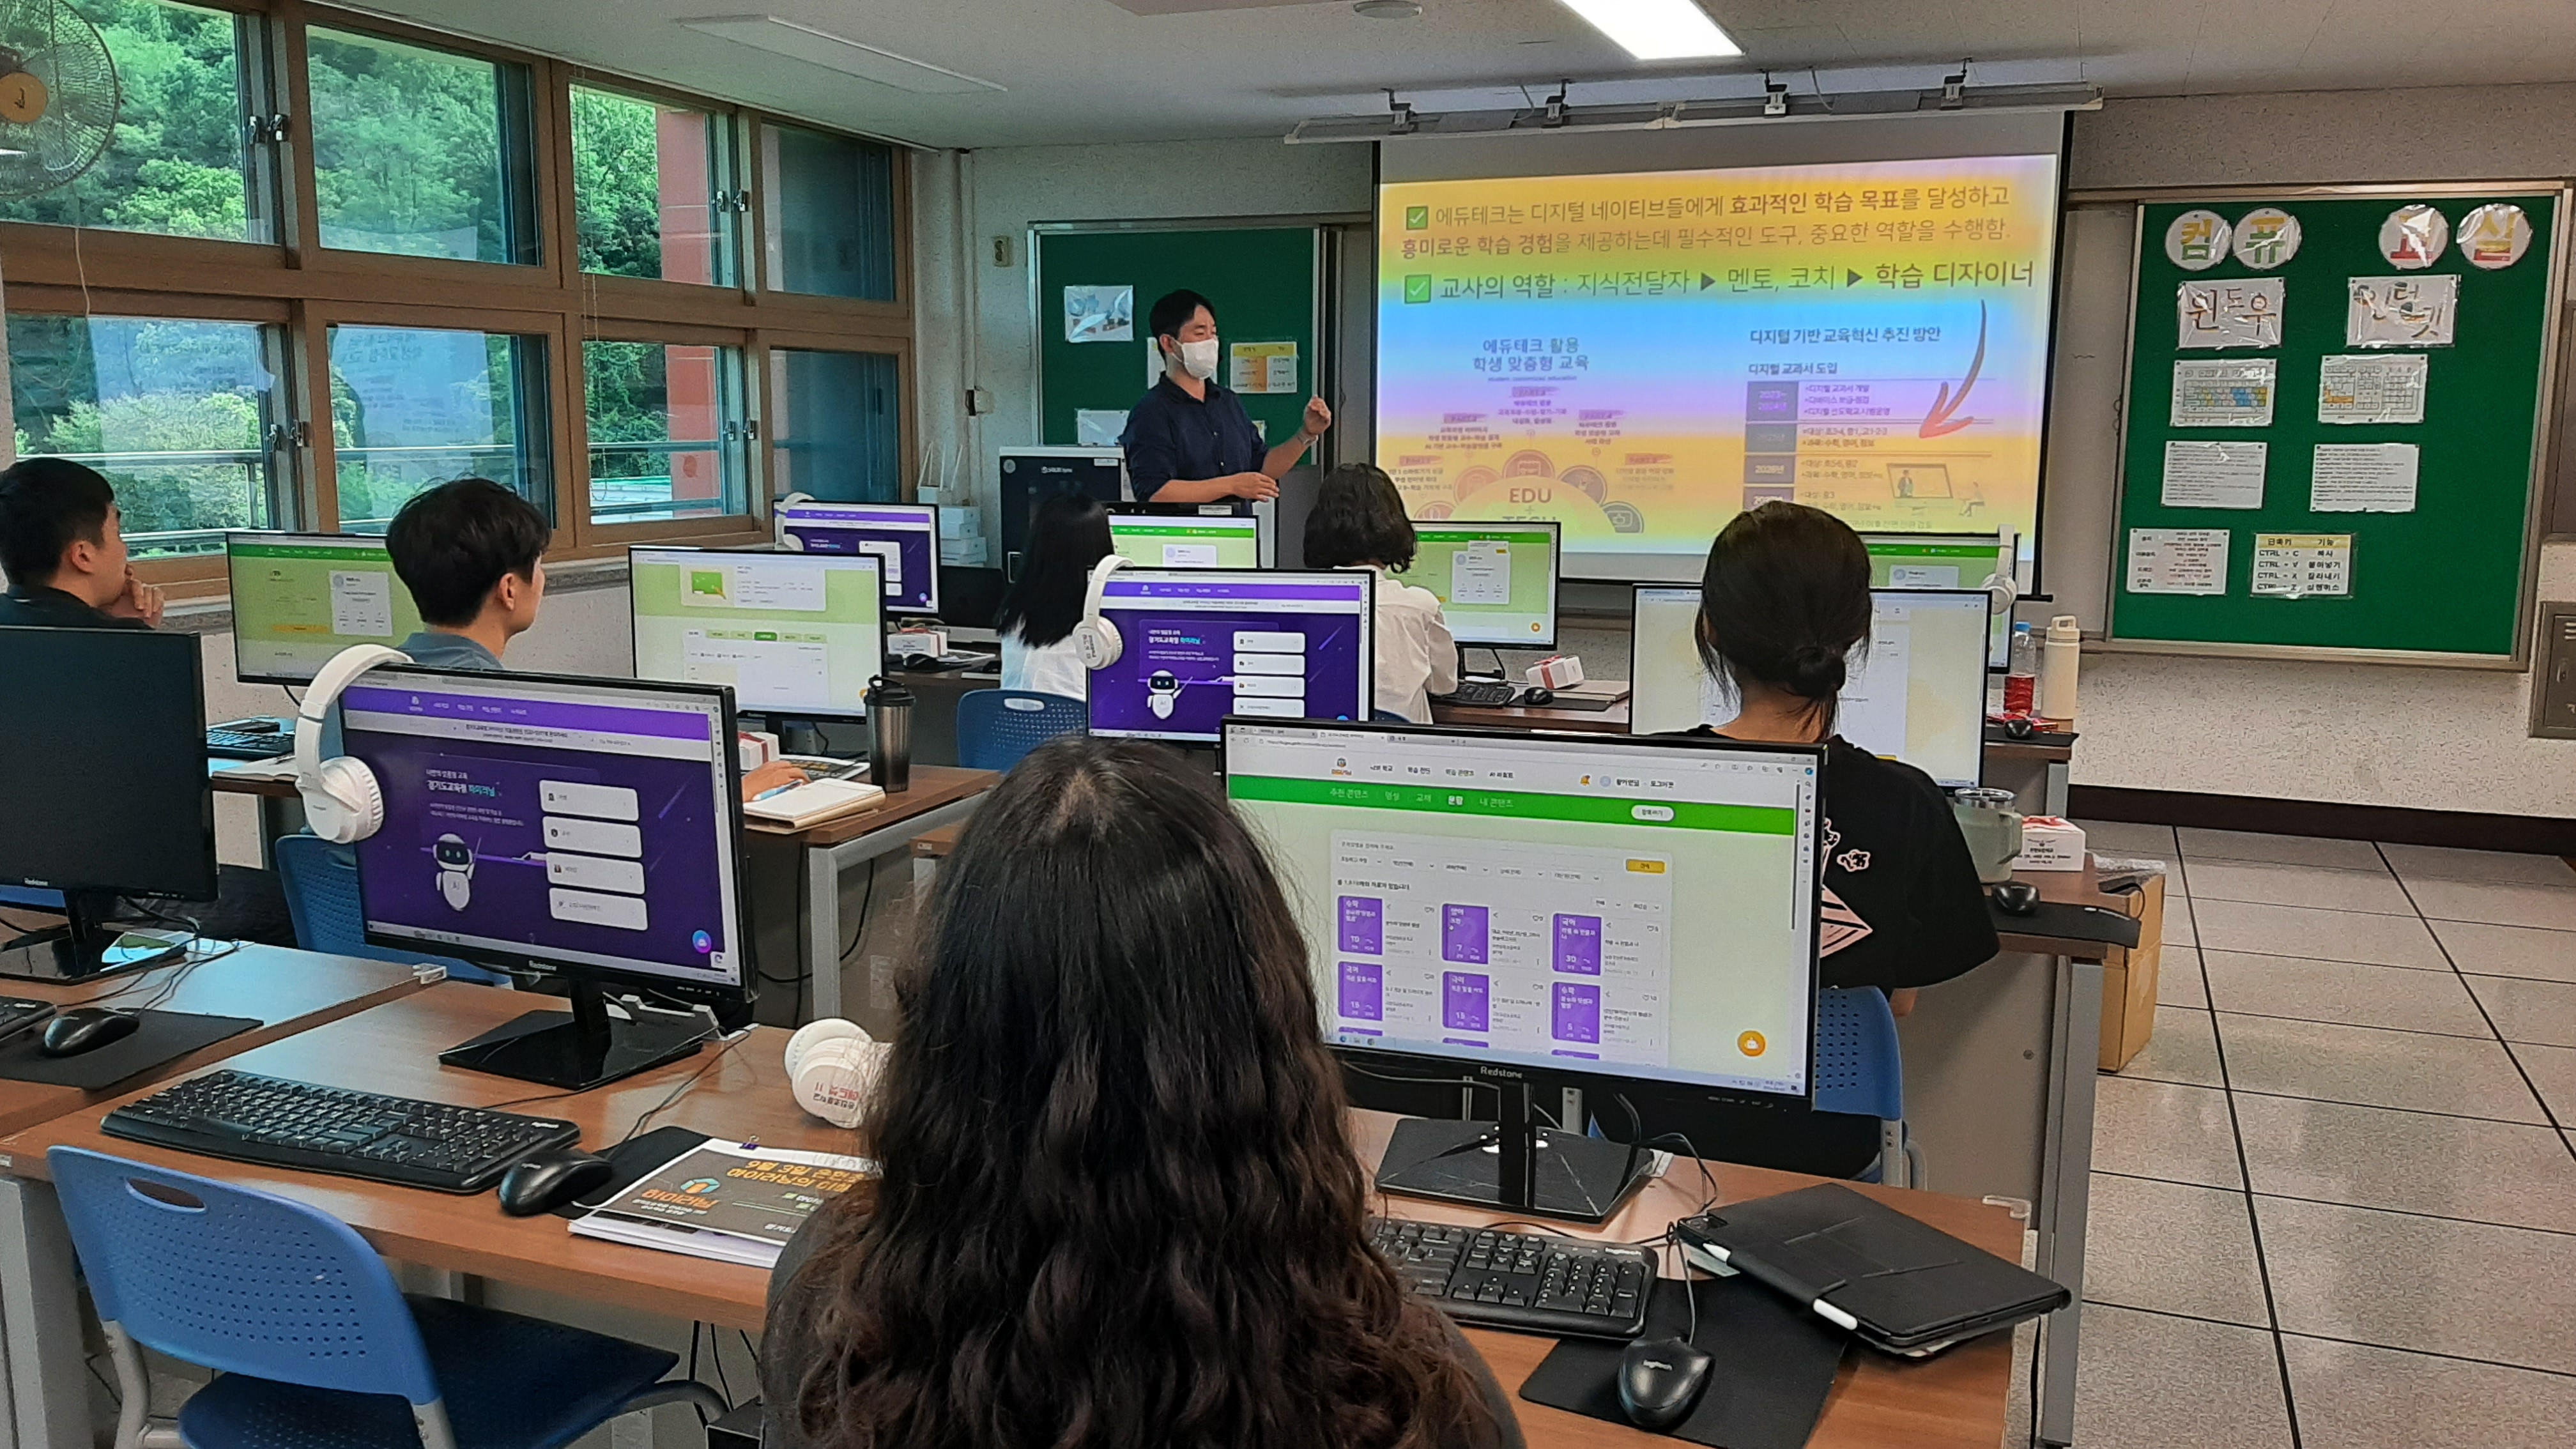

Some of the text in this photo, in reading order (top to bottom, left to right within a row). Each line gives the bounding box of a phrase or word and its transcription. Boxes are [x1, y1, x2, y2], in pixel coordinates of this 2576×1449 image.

[1436, 185, 2010, 227] 에듀테크는 디지털 네이티브들에게 효과적인 학습 목표를 달성하고
[1400, 218, 2011, 259] 흥미로운 학습 경험을 제공하는데 필수적인 도구, 중요한 역할을 수행함.
[1440, 274, 1504, 299] 교사의
[1512, 273, 1556, 298] 역할
[1577, 269, 1690, 296] 지식전달자
[1728, 266, 1779, 293] 멘토,
[1788, 265, 1835, 290] 코치
[1876, 263, 1924, 289] 학습
[1933, 260, 2034, 288] 디자이너
[2185, 288, 2276, 335] 윈도우
[1750, 326, 1941, 344] 디지털 기반 교육혁신 추진 방안
[1483, 337, 1579, 355] 에듀테크 활용
[1473, 355, 1590, 372] 학생 맞춤형 교육
[1749, 362, 1837, 375] 디지털 교과서 도입
[1510, 488, 1552, 503] EDU
[2317, 538, 2334, 546] 기능
[1346, 788, 1368, 799] 콘텐츠
[1489, 799, 1514, 808] 콘텐츠
[1565, 954, 1576, 963] 30
[1480, 1066, 1522, 1079] Redstone
[745, 1160, 779, 1171] 9월
[778, 1165, 812, 1176] 3일
[1604, 1247, 1642, 1256] logitech
